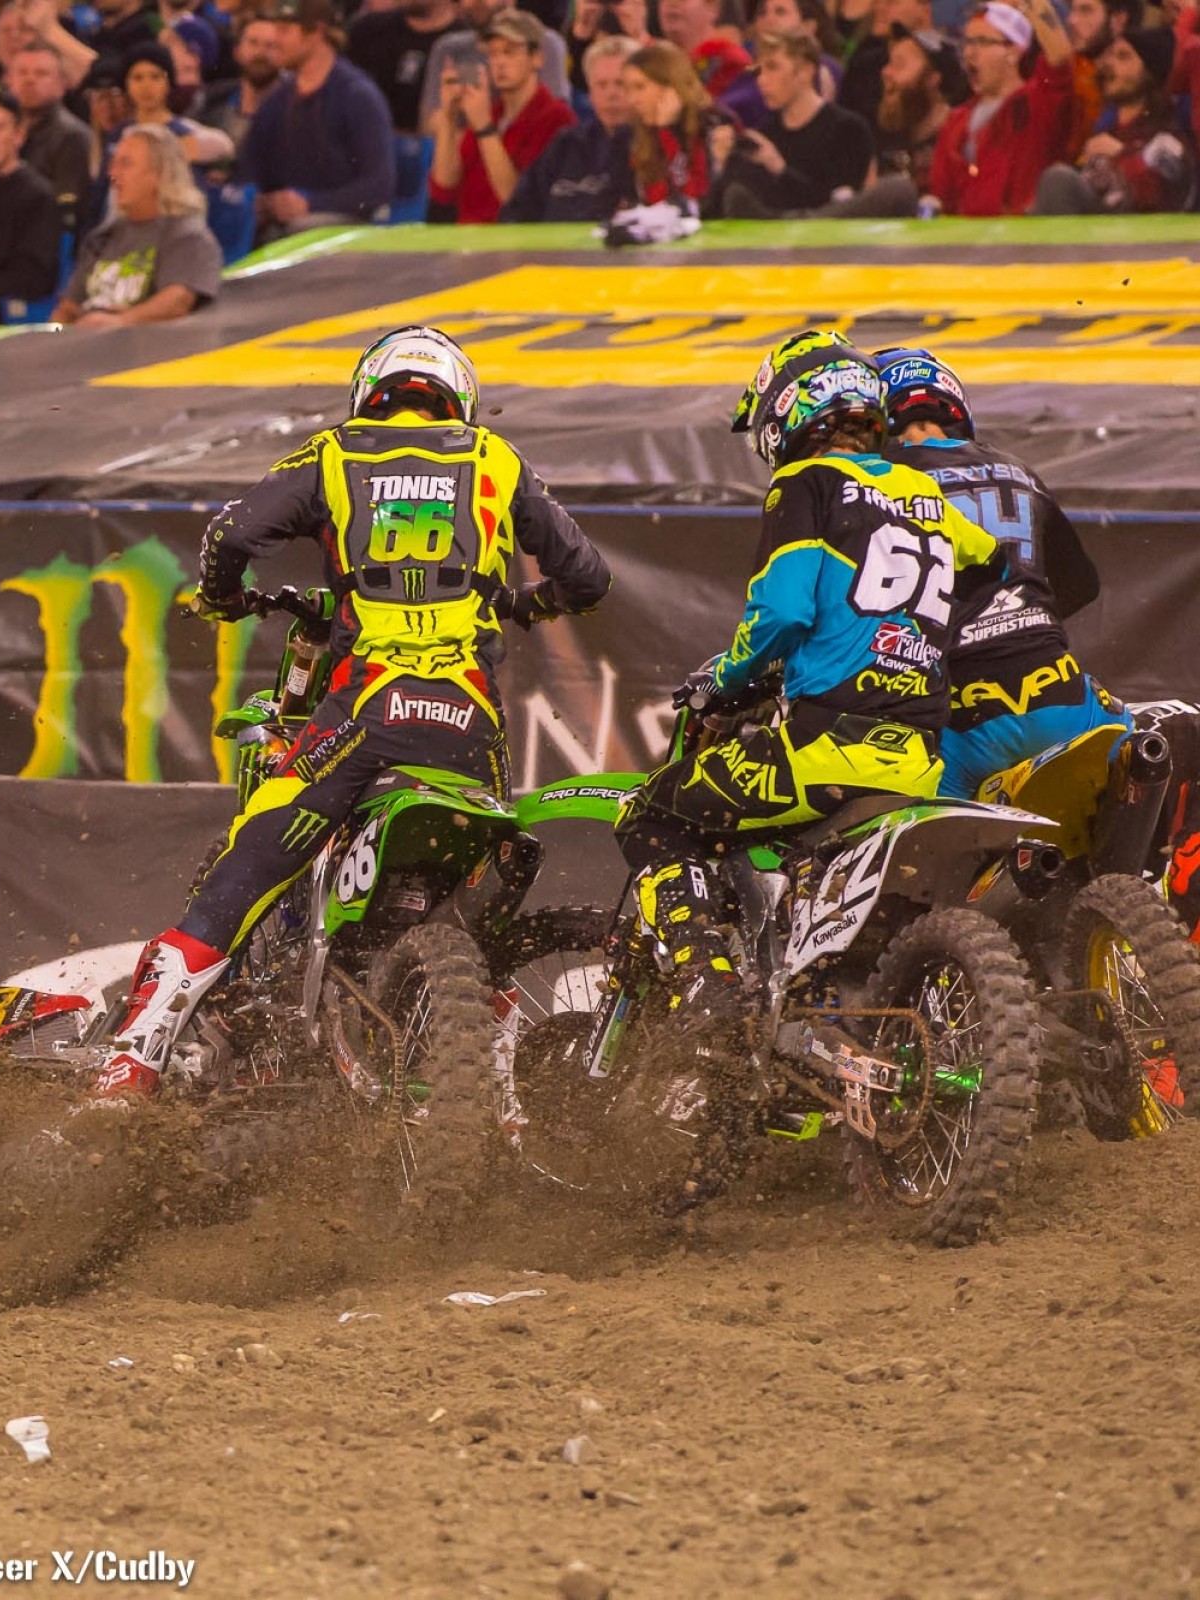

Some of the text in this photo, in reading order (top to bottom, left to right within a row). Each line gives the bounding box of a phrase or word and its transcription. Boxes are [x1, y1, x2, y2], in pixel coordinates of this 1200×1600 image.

[776, 386, 796, 412] BELL
[369, 474, 455, 501] TONUS
[929, 463, 1036, 489] BERTSO
[368, 500, 455, 562] 66
[853, 522, 955, 627] 62
[388, 691, 475, 731] Arnaud
[541, 789, 576, 803] PRO
[338, 818, 377, 903] 66
[812, 911, 858, 945] Kawasaki
